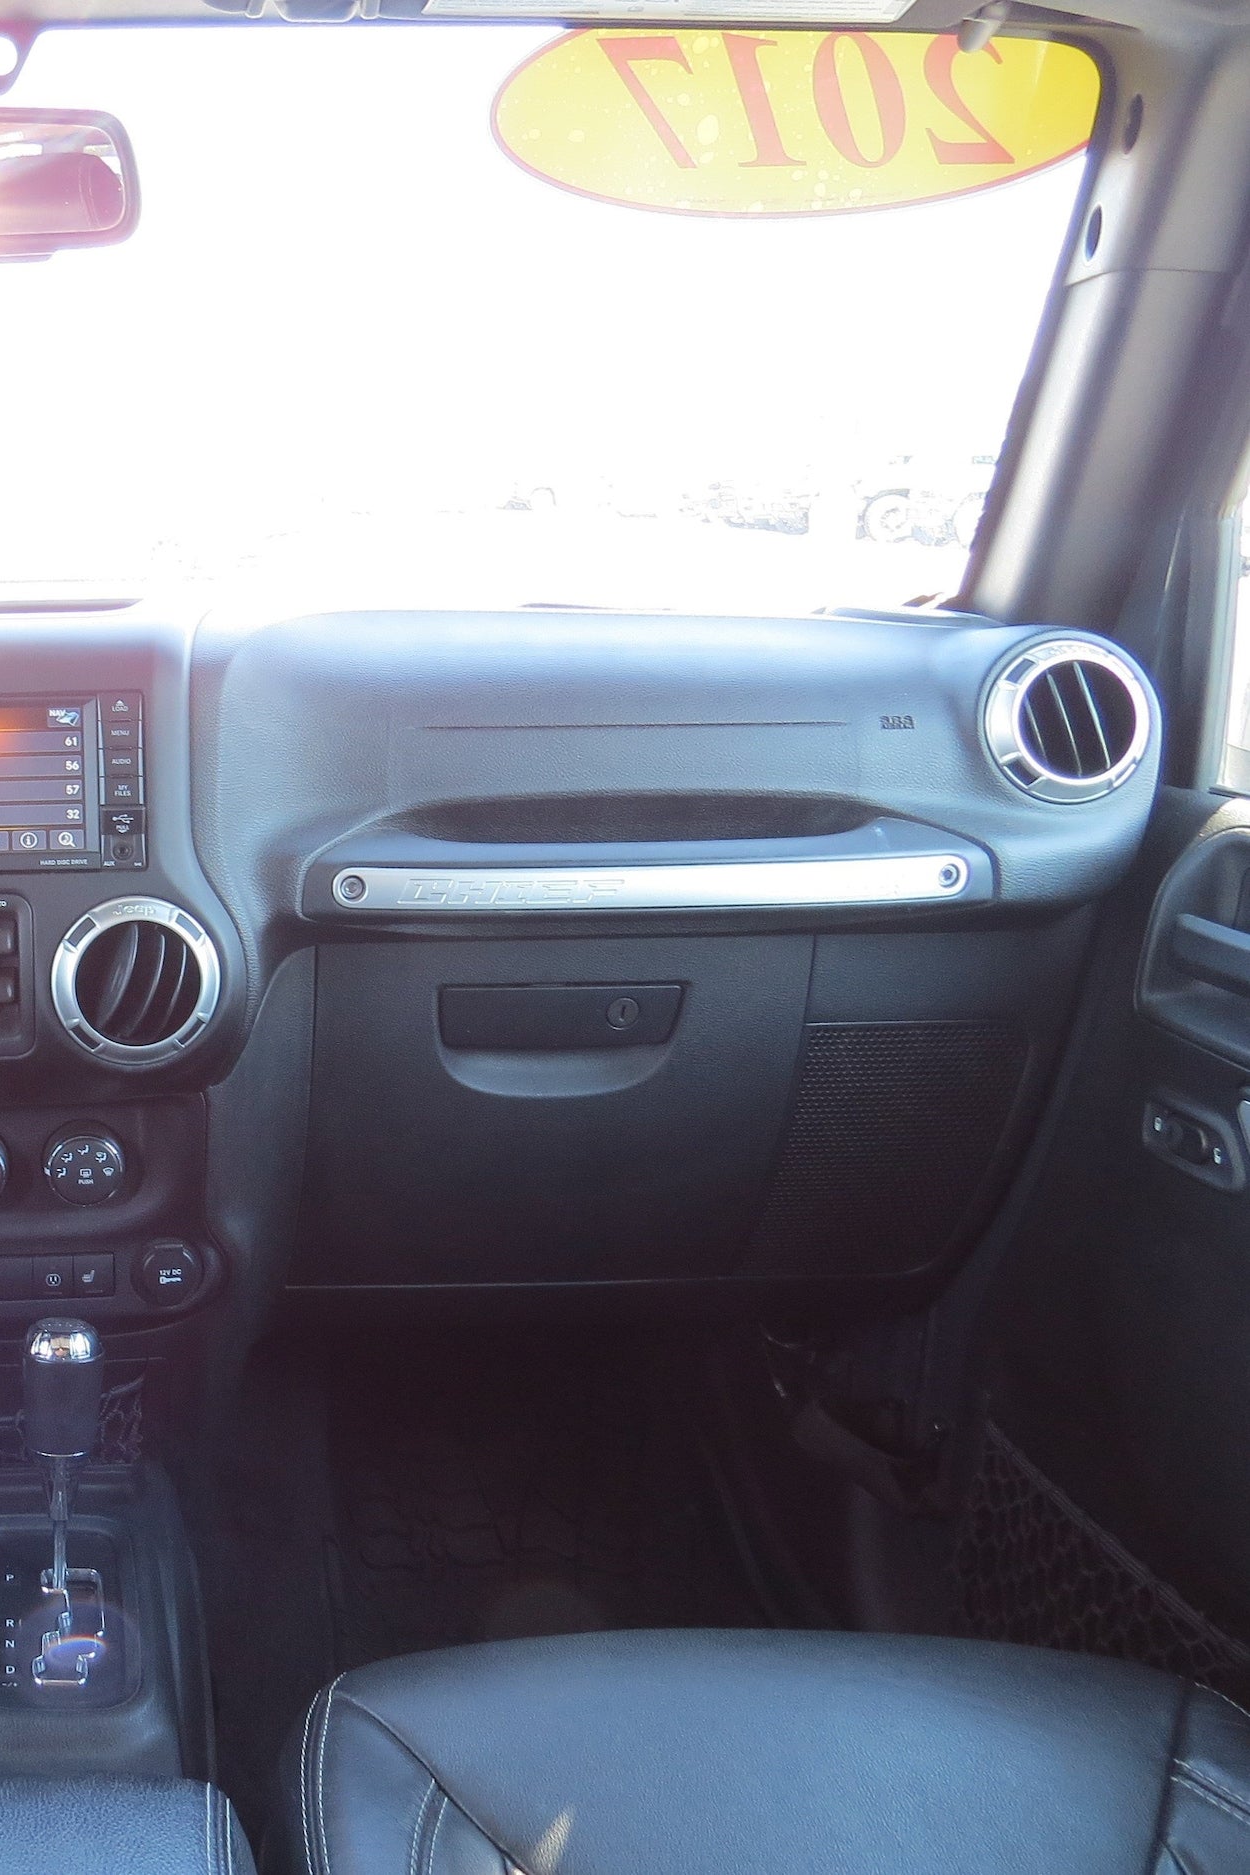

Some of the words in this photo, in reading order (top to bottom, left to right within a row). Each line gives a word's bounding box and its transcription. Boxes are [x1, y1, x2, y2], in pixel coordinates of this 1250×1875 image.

[49, 709, 66, 717] NAV
[64, 736, 78, 747] 61
[65, 760, 80, 771] 56
[66, 785, 80, 795] 57
[66, 809, 80, 820] 32
[397, 878, 625, 905] CHIEF
[171, 1268, 182, 1276] DC
[5, 1619, 15, 1628] R
[5, 1639, 15, 1648] N
[5, 1665, 16, 1674] D
